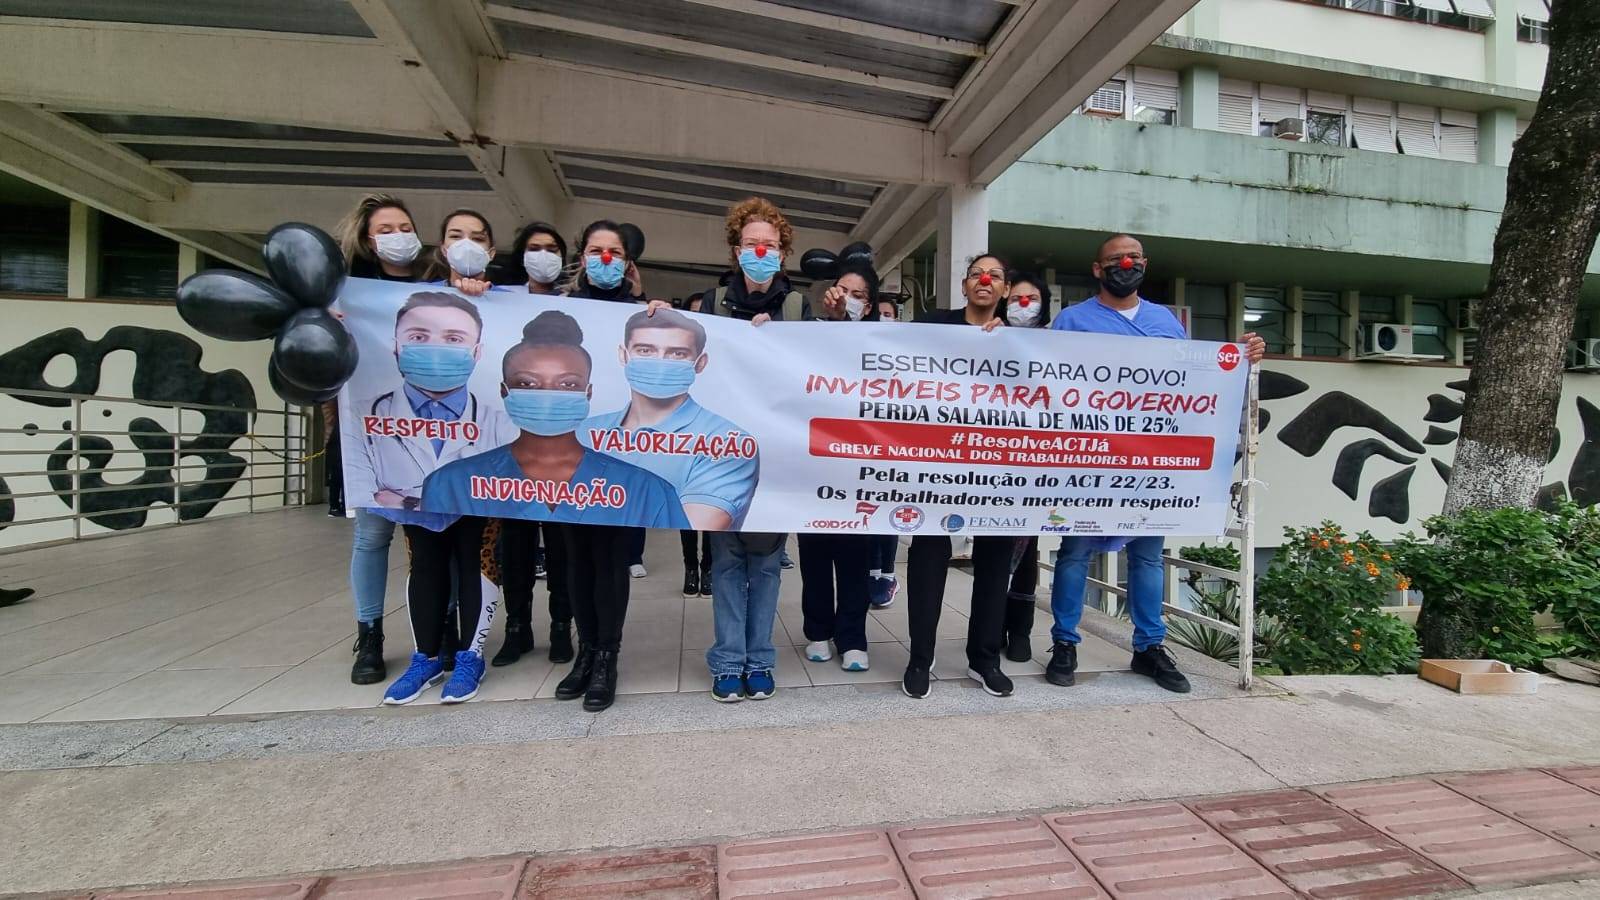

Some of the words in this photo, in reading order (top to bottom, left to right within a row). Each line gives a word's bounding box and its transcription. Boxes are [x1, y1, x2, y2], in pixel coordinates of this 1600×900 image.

[861, 353, 1020, 378] ESSENCIAIS
[1028, 361, 1087, 381] PARA
[1094, 366, 1111, 383] O
[1118, 367, 1186, 387] POVO!
[806, 372, 961, 402] INVISÍVEIS
[970, 383, 1051, 410] PARA
[1062, 388, 1080, 408] O
[1088, 390, 1217, 415] GOVERNO!
[363, 416, 479, 441] RESPEITO
[859, 401, 929, 422] PERDA
[937, 406, 1032, 428] SALARIAL
[1039, 412, 1064, 430] DE
[1071, 413, 1109, 431] MAIS
[1115, 416, 1136, 432] DE
[1142, 417, 1179, 434] 25%
[589, 428, 757, 460] VALORIZAÇÃO
[829, 442, 882, 456] GREVE
[888, 445, 964, 460] NACIONAL
[970, 450, 1002, 461] DOS
[1007, 451, 1128, 466] TRABALHADORES
[1132, 456, 1149, 466] DA
[1153, 456, 1201, 467] EBSERH
[471, 475, 626, 509] INDIGNAÇÃO
[859, 466, 910, 483] Pela
[918, 471, 1027, 490] resolução
[1035, 474, 1059, 488] do
[1065, 474, 1104, 488] ACT
[1110, 476, 1175, 492] 22/23.
[817, 485, 847, 500] Os
[856, 487, 1014, 506] trabalhadores
[1022, 495, 1114, 508] merecem
[1120, 496, 1200, 511] respeito!
[969, 516, 1027, 527] FENAM
[1117, 522, 1135, 530] FNE
